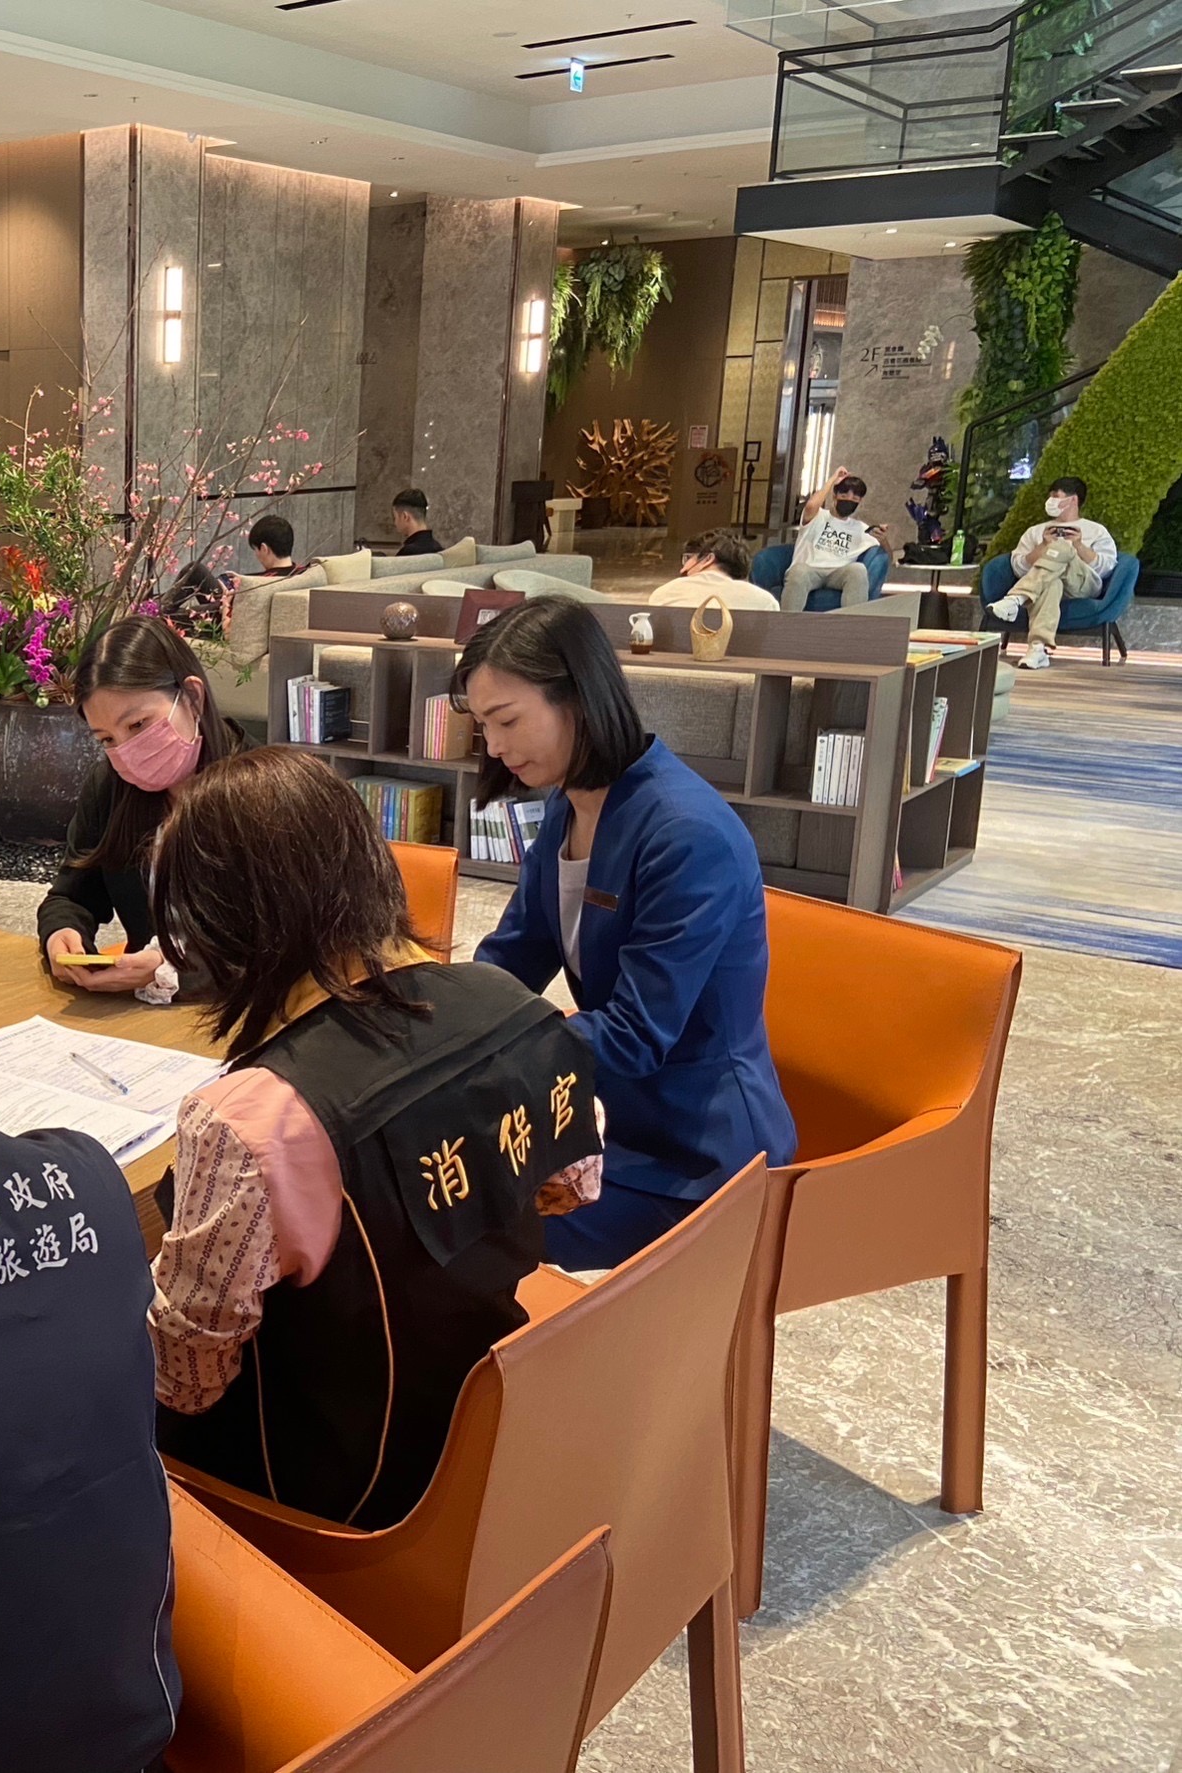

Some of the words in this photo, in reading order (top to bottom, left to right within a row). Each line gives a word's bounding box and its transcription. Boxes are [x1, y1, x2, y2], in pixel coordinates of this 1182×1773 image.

[860, 346, 881, 362] 2F
[419, 1072, 576, 1211] 消保官
